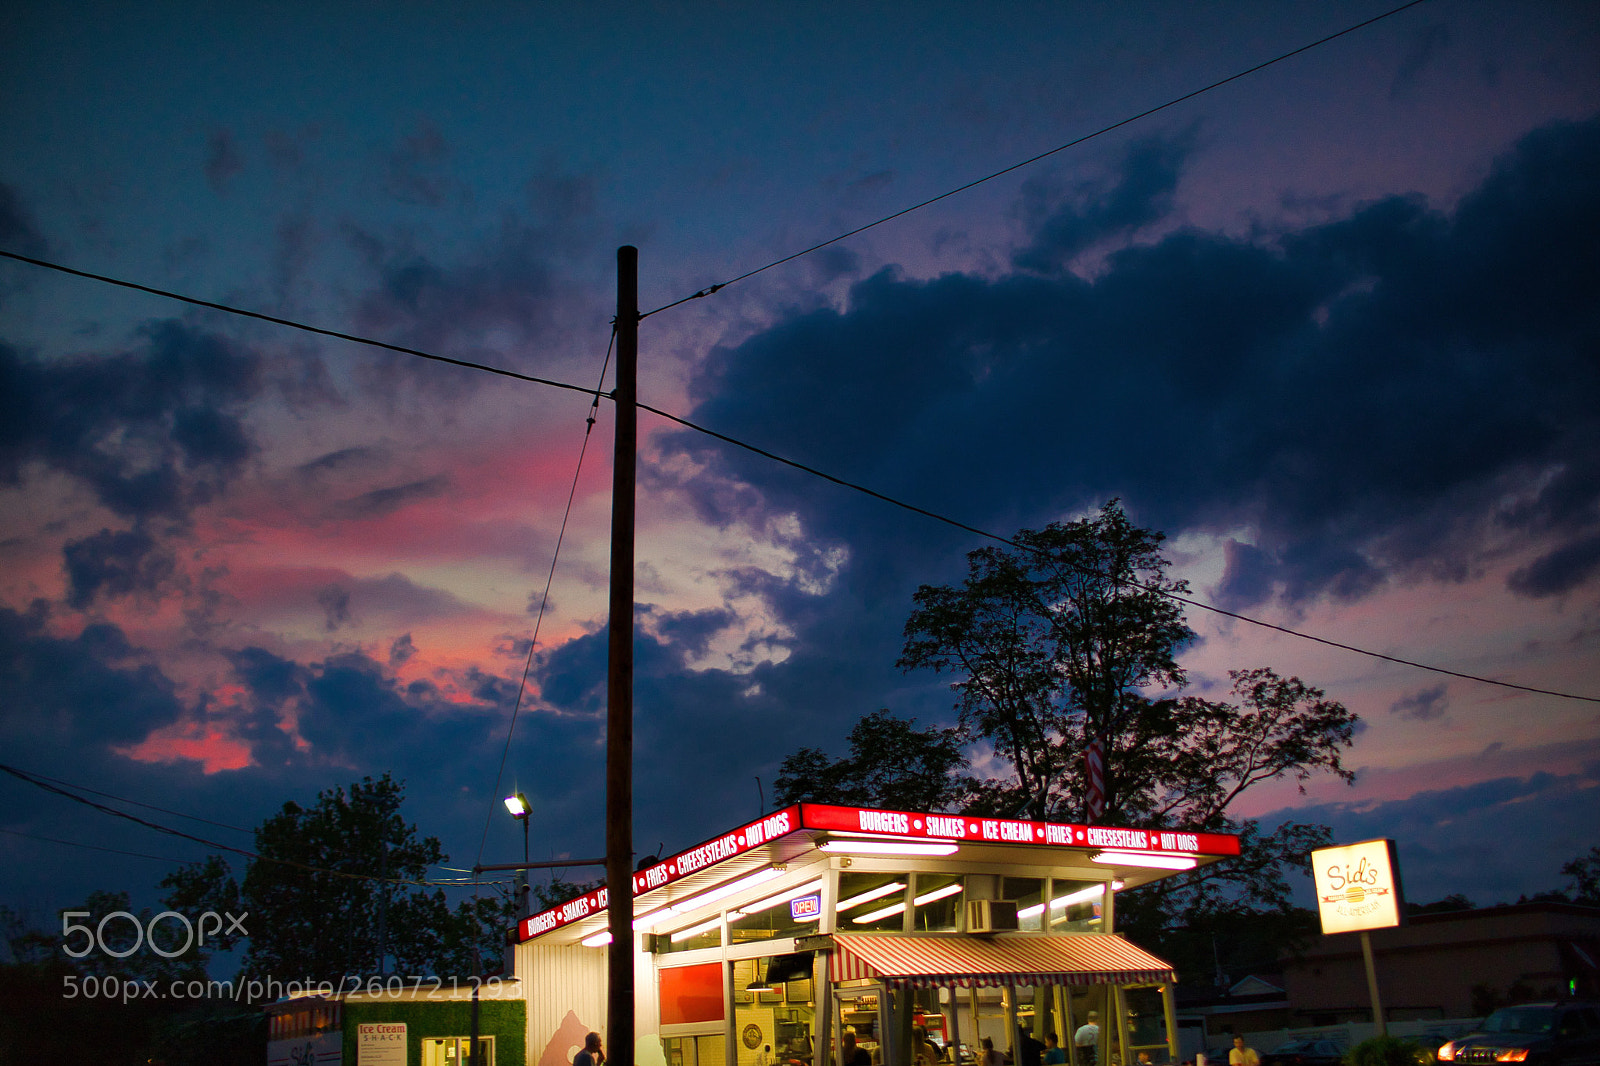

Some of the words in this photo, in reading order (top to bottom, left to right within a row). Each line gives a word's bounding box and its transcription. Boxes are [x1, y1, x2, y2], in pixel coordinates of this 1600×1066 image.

[859, 810, 909, 834] BURGERS
[926, 816, 966, 838] SHAKES
[982, 820, 999, 840] ICE
[1000, 821, 1034, 842] CREAM
[1047, 825, 1073, 844] FRIES
[1087, 827, 1148, 848] CHEESESTEAKS
[1160, 832, 1177, 850] HOT
[1178, 834, 1199, 851] DOGS
[527, 910, 557, 937] BURGERS
[562, 897, 590, 922] SHAKES
[645, 863, 668, 889] FRIES
[676, 834, 738, 875] CHEESESTEAKS
[745, 822, 763, 848] HOT
[763, 812, 790, 840] DOGS
[1327, 856, 1378, 891] Sid's
[794, 899, 817, 914] OPEN
[360, 1025, 374, 1034] Ice
[377, 1024, 406, 1034] Cream
